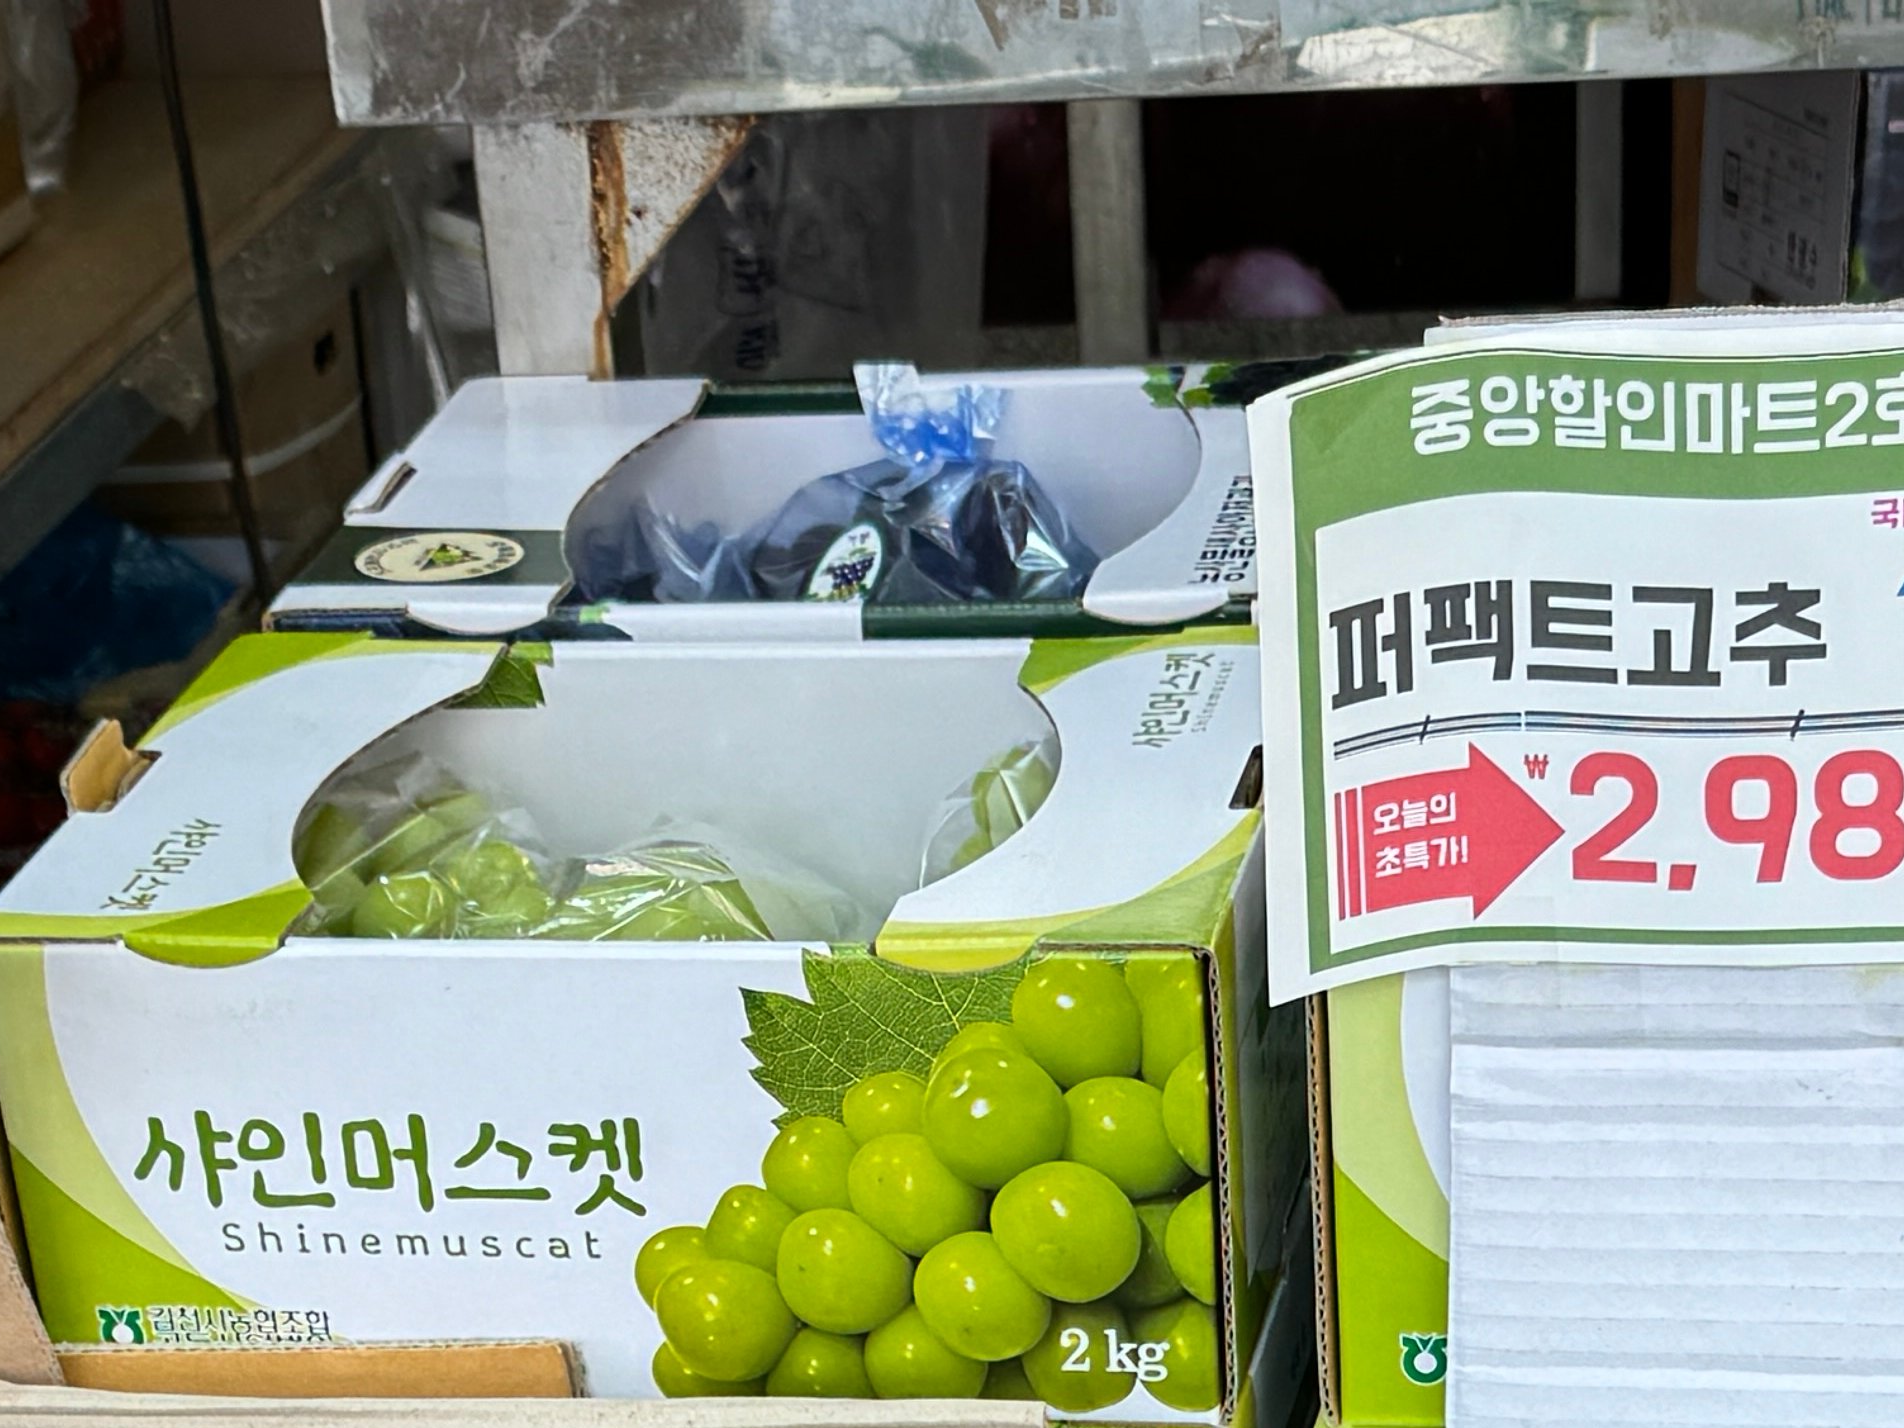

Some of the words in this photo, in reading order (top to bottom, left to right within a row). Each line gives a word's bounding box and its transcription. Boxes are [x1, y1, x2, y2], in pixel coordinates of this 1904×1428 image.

[1328, 580, 1829, 712] 퍼팩트고추
[1131, 652, 1216, 749] 샤인머스켓
[1371, 791, 1457, 835] 오늘의
[99, 819, 222, 911] 샤인머스켓
[1374, 835, 1469, 879] 초특가!
[133, 1109, 648, 1218] 샤인머스켓
[221, 1221, 604, 1260] Shinemuscat
[1059, 1327, 1091, 1373] 2
[1103, 1328, 1172, 1383] kg
